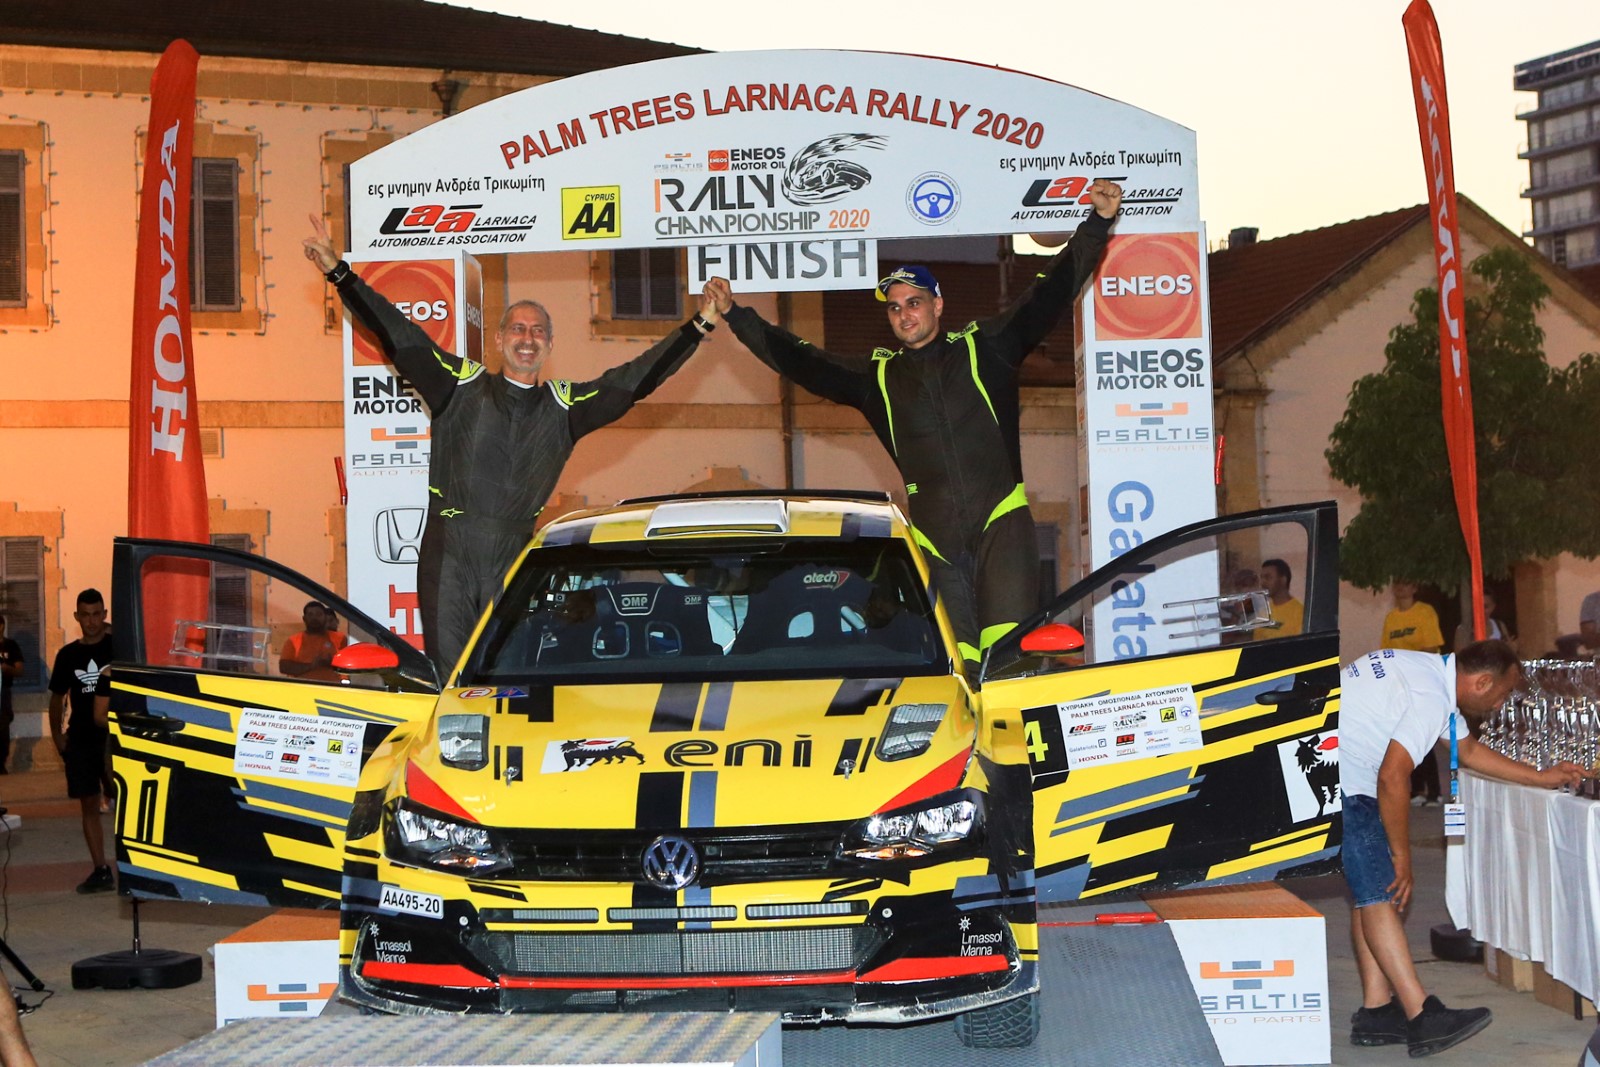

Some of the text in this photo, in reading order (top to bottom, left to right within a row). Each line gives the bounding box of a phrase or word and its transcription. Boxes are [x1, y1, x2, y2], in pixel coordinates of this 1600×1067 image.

[500, 83, 1044, 169] PALM TREES LARNACA RALLY 2020
[730, 147, 786, 161] ENEOS
[1000, 149, 1182, 172] εις μνημην Ανδρέα Τρικωμίτη
[731, 160, 786, 171] MOTOR OIL
[368, 174, 545, 198] εις μνημην Ανδρέα Τρικωμίτη
[654, 174, 775, 213] RALLY
[584, 192, 615, 202] CYPRUS
[474, 214, 537, 227] LARNACA
[568, 202, 615, 235] AA
[654, 208, 870, 235] CHAMPIONSHIP 2020
[1011, 208, 1089, 220] AUTOMOBILE
[368, 233, 527, 248] AUTOMOBILE ASSOCIATION
[698, 240, 867, 281] FINISH
[151, 119, 188, 463] HONDA
[1101, 274, 1194, 297] ENEOS
[1095, 348, 1204, 374] ENEOS
[1096, 373, 1205, 390] MOTOR OIL
[353, 399, 422, 415] MOTOR
[1096, 427, 1209, 442] PSALTIS
[803, 570, 838, 584] atech
[621, 596, 648, 607] OMP
[684, 596, 702, 604] OMP
[1371, 661, 1386, 679] 2020
[1071, 711, 1089, 719] PALM
[1090, 708, 1112, 716] TREES
[1113, 702, 1145, 713] LARNACA
[1163, 711, 1175, 720] AA
[249, 719, 354, 738] PALM TREES LARNACA RALLY 2020
[329, 743, 342, 752] AA
[1024, 720, 1049, 762] 4
[663, 734, 813, 768] eni
[1079, 753, 1108, 762] HONDA
[382, 889, 440, 914] AA495-20
[374, 938, 412, 952] Limassol
[962, 930, 1003, 945] Limassol
[376, 950, 407, 964] Marina
[960, 944, 993, 957] Marina
[1200, 993, 1321, 1010] SALTIS
[1254, 1015, 1321, 1024] PARTS
